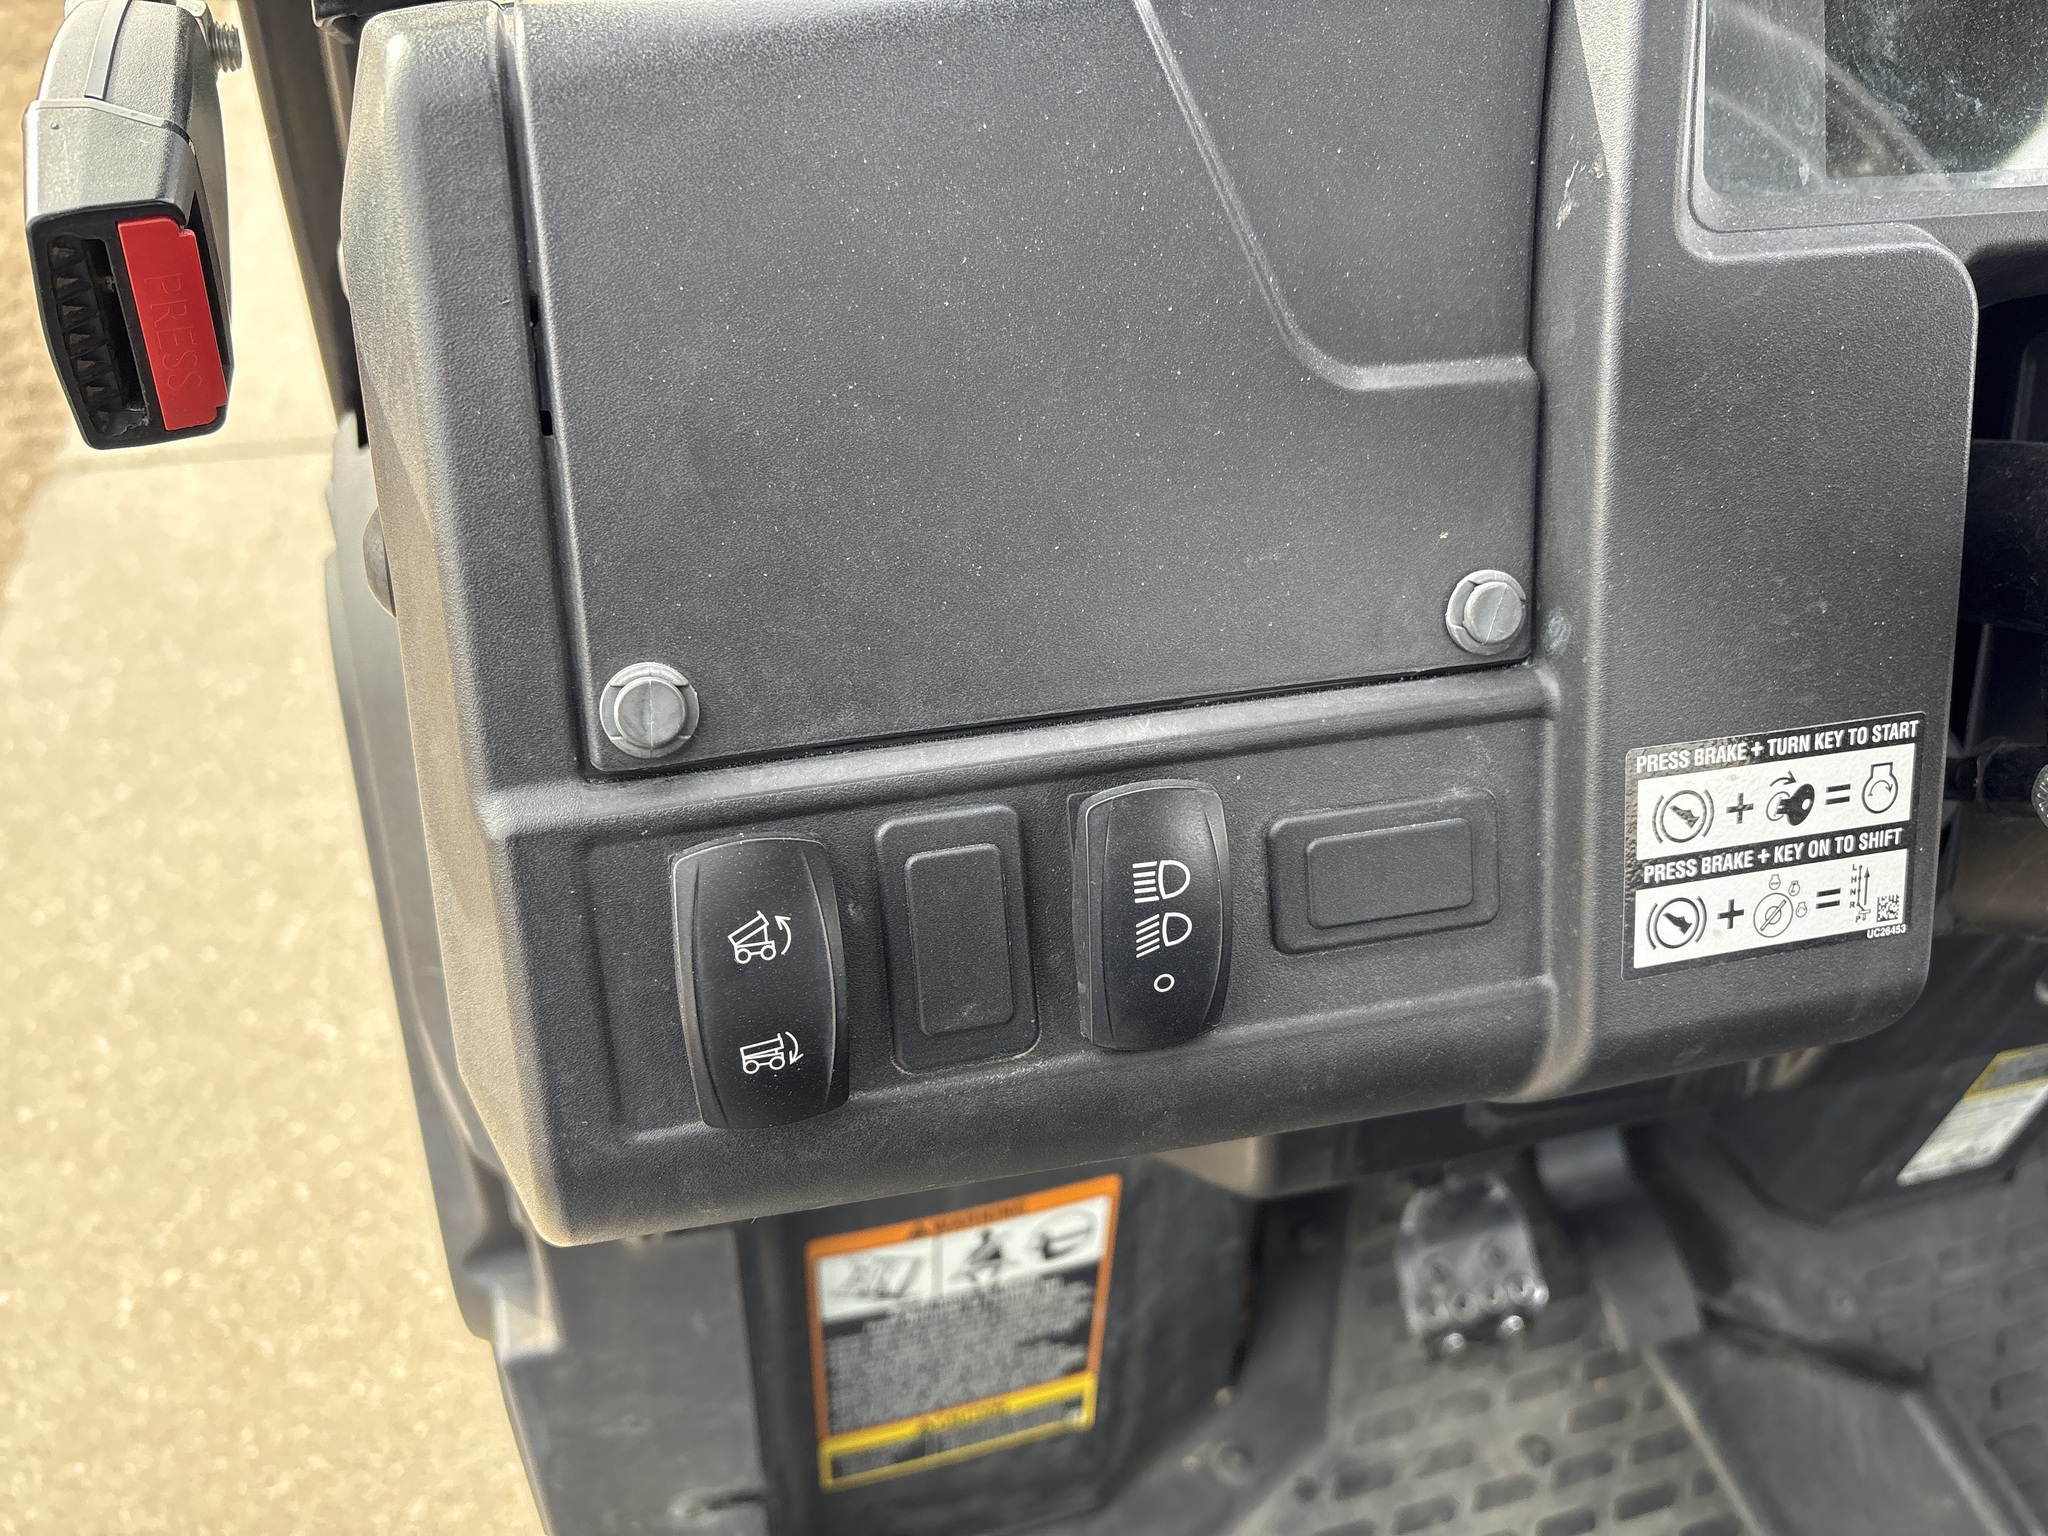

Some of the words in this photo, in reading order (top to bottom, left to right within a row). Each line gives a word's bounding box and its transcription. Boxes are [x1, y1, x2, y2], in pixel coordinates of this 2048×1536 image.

[144, 272, 204, 392] PRESS
[1636, 749, 1690, 774] PRESS
[1694, 742, 1748, 767] BRAKE
[1750, 743, 1764, 757] +
[1767, 734, 1811, 758] TURN
[1814, 730, 1844, 751] KEY
[1848, 727, 1868, 747] TO
[1872, 720, 1919, 743] START
[1643, 858, 1697, 884] PRESS
[1702, 849, 1754, 875] BRAKE
[1757, 850, 1771, 865] +
[1773, 841, 1804, 864] KEY
[1807, 836, 1832, 858] ON
[1835, 834, 1855, 854] TO
[1858, 827, 1903, 850] SHIFT
[1851, 876, 1858, 884] H
[1850, 888, 1857, 896] N
[1849, 901, 1856, 909] R
[1855, 915, 1861, 923] P
